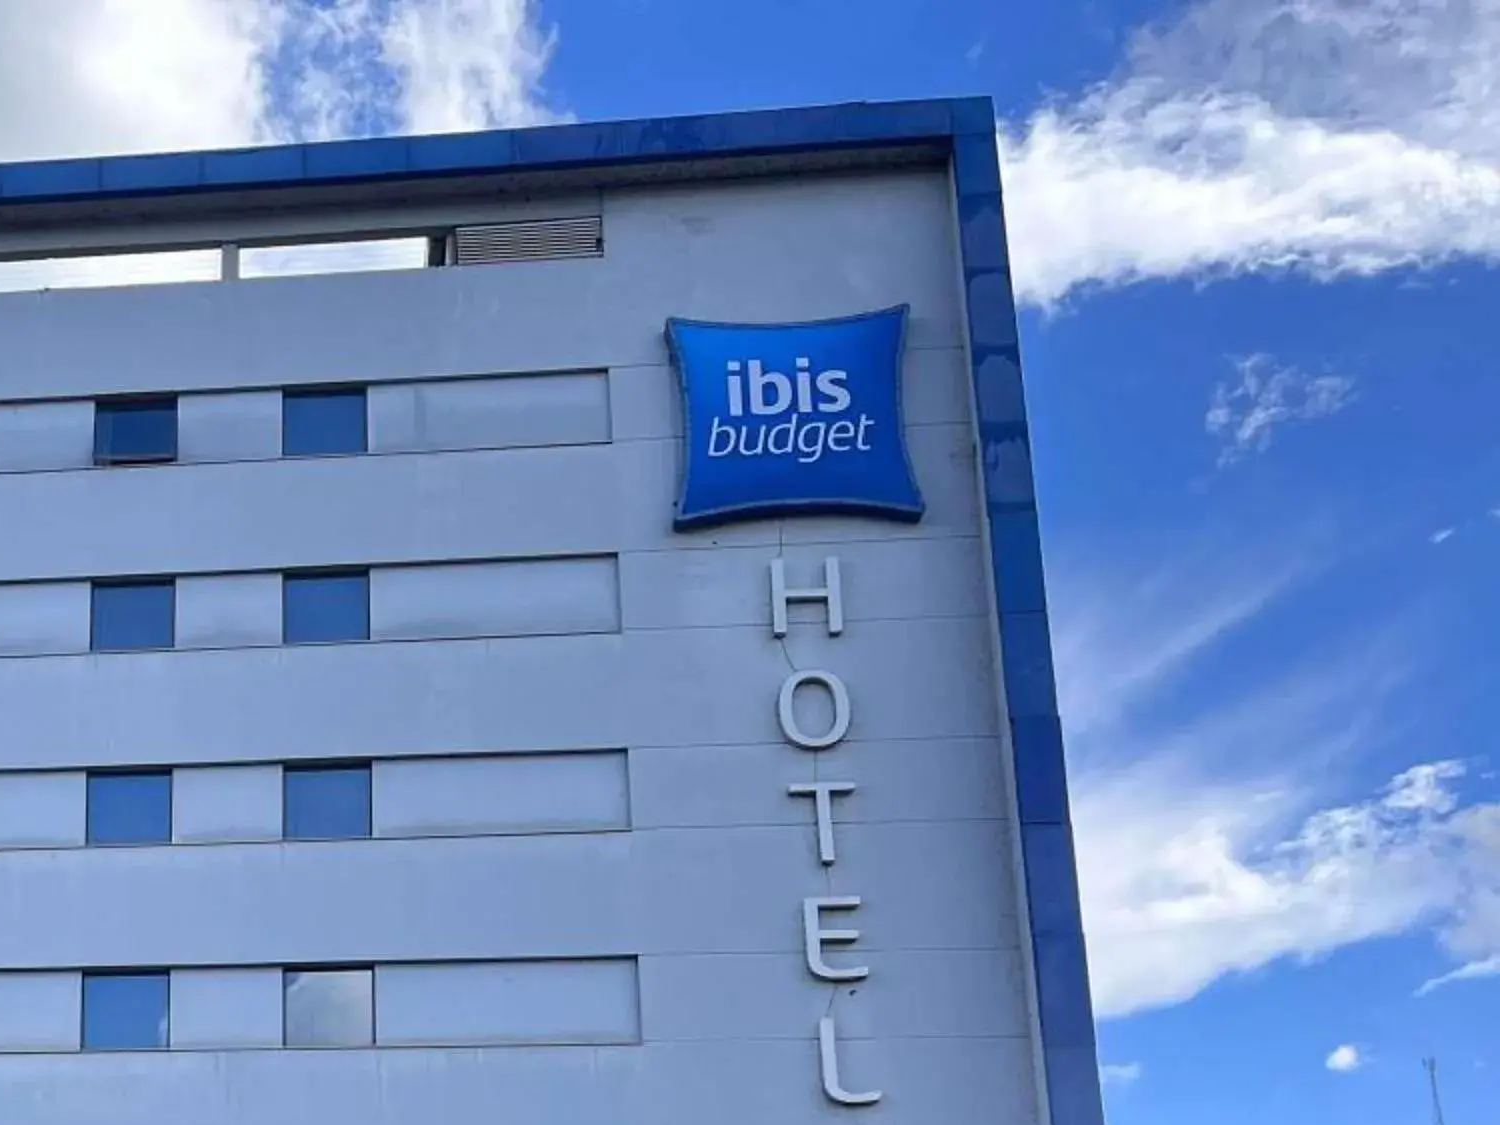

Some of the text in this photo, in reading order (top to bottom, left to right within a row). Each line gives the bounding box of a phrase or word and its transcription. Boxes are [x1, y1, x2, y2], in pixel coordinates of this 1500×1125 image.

[727, 357, 851, 416] ibis
[707, 414, 875, 463] budget
[768, 556, 882, 1105] HOTEL
